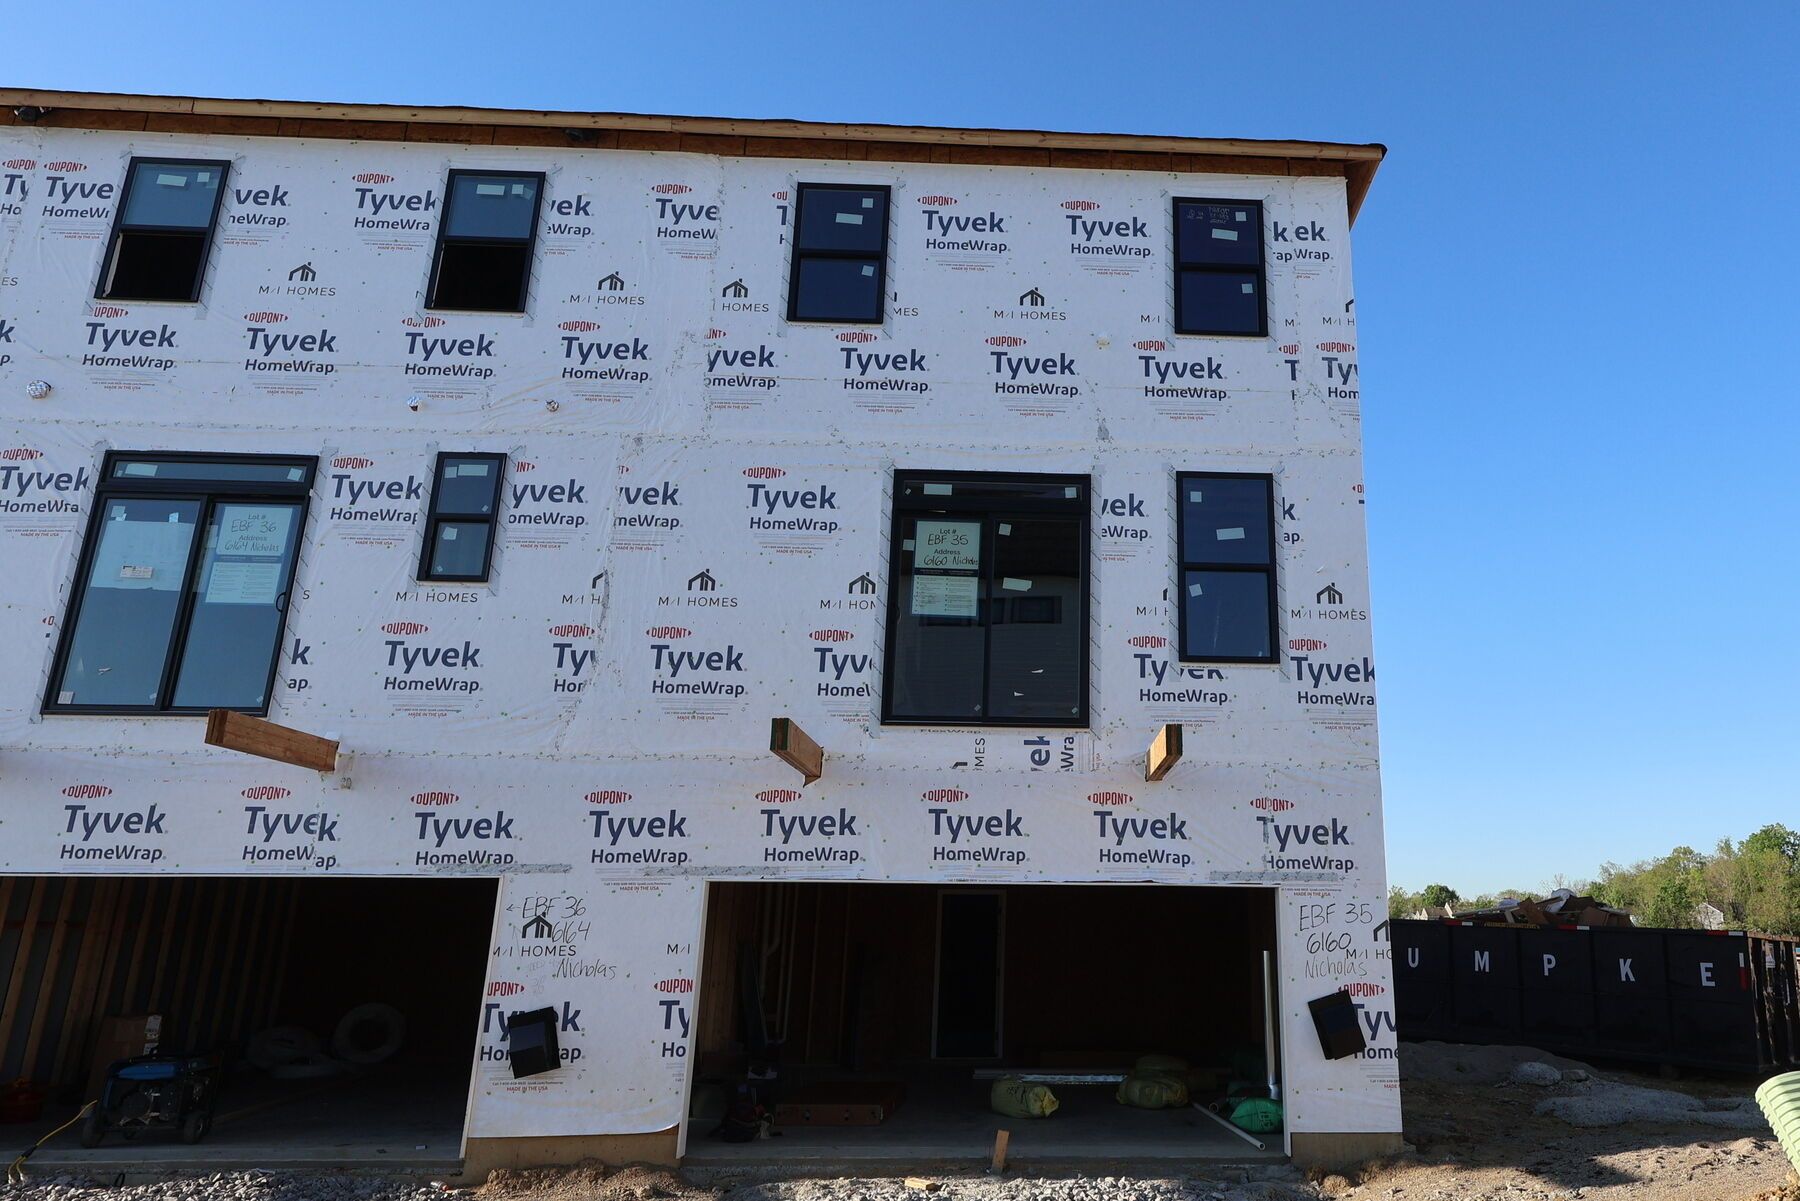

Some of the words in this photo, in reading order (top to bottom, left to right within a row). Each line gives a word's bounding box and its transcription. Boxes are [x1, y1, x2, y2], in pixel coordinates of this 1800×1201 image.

[7, 159, 36, 171] DUPON
[49, 162, 83, 173] DUPONT
[357, 173, 390, 184] DUPONT
[46, 176, 113, 204] Tyve
[235, 185, 288, 206] vek
[656, 184, 688, 194] DUPONT
[355, 188, 435, 215] Tyvek
[922, 196, 954, 206] DUPONT
[1065, 201, 1096, 211] DUPONT
[42, 206, 109, 219] HomeWr
[656, 198, 718, 225] Tyve
[354, 217, 430, 231] HomeWra
[547, 223, 591, 238] eWrap
[922, 210, 1005, 236] Tyvek
[1066, 214, 1148, 241] Tyvek
[657, 227, 716, 239] HomeW
[926, 238, 1007, 254] HomeWrap
[1071, 243, 1151, 258] HomeWrap
[1294, 248, 1330, 261] Wrap
[287, 287, 336, 296] HOMES
[598, 296, 645, 305] HOMES
[722, 302, 769, 312] HOMES
[94, 306, 124, 318] UPONT
[249, 312, 284, 323] DUPONT
[893, 307, 919, 316] MES
[1021, 311, 1067, 321] HOMES
[562, 321, 597, 332] DUPONT
[86, 322, 177, 352] Tyvek
[247, 327, 336, 356] Tyvek
[840, 332, 873, 343] DUPONT
[990, 336, 1023, 347] DUPONT
[405, 332, 495, 361] Tyvek
[561, 336, 648, 365] Tyvek
[1137, 340, 1165, 351] DUPON
[1320, 342, 1351, 353] DUPONT
[82, 354, 174, 371] HomeWrap
[707, 345, 775, 372] yvek
[840, 347, 926, 376] Tyvek
[990, 351, 1076, 380] Tyvek
[245, 359, 334, 375] HomeWrap
[405, 363, 493, 380] HomeWrap
[562, 367, 649, 383] HomeWrap
[1138, 355, 1223, 384] Tyvek
[704, 375, 776, 390] omeWrap
[843, 378, 928, 394] HomeWrap
[995, 382, 1079, 398] HomeWrap
[1144, 386, 1227, 401] HomeWrap
[3, 449, 39, 460] DUPONT
[334, 457, 369, 469] DUPONT
[748, 467, 781, 479] DUPONT
[331, 474, 423, 505] Tyvek
[512, 479, 585, 508] yvek
[619, 481, 679, 506] vek
[0, 500, 79, 513] HomeWra
[747, 484, 836, 514] Tyvek
[231, 519, 253, 532] EBF
[260, 521, 276, 533] 36
[508, 512, 584, 528] omeWrap
[750, 517, 837, 533] HomeWrap
[928, 534, 948, 545] EBF
[951, 534, 969, 545] 35
[1101, 525, 1148, 541] eWrap
[923, 555, 947, 566] 6160
[426, 593, 478, 603] HOMES
[688, 597, 738, 607] HOMES
[1319, 610, 1366, 620] HOMES
[387, 622, 424, 635] DUPONT
[554, 625, 590, 637] DUPONT
[652, 627, 687, 639] DUPONT
[814, 630, 849, 642] DUPONT
[1133, 636, 1167, 649] DUPONT
[1289, 639, 1322, 650] DUPONT
[385, 640, 480, 674] Tyvek
[650, 645, 743, 677] Tyvek
[814, 648, 872, 680] Tyv
[1290, 656, 1375, 688] Tyvek
[384, 676, 479, 694] HomeWrap
[652, 680, 744, 697] HomeWrap
[817, 683, 870, 697] Home
[1139, 689, 1228, 705] HomeWrap
[1297, 691, 1374, 705] HomeWra
[974, 738, 986, 767] MES
[68, 785, 108, 798] DUPONT
[247, 786, 286, 800] DUPONT
[416, 792, 455, 805] DUPONT
[590, 791, 627, 804] DUPONT
[761, 790, 796, 802] DUPONT
[928, 789, 964, 802] DUPONT
[1093, 792, 1128, 805] DUPONT
[65, 804, 166, 841] Tyvek
[245, 806, 338, 842] Tyvek
[415, 811, 514, 847] Tyvek
[589, 810, 687, 846] Tyvek
[760, 808, 857, 844] Tyvek
[928, 809, 1023, 843] Tyvek
[1093, 811, 1187, 846] Tyvek
[1256, 816, 1350, 852] Tyvek
[60, 844, 162, 863] HomeWrap
[242, 845, 336, 870] HomeWap
[416, 850, 514, 865] HomeWrap
[591, 849, 688, 865] HomeWrap
[765, 847, 859, 864] HomeWrap
[934, 847, 1025, 864] HomeWrap
[1099, 849, 1191, 865] HomeWrap
[522, 897, 560, 919] EBF
[561, 897, 586, 918] 36
[1300, 903, 1336, 931] EBF
[1345, 903, 1372, 924] 35
[552, 921, 591, 943] 6164
[521, 945, 577, 957] HOMES
[1307, 932, 1351, 954] 6160
[557, 959, 616, 979] Nicholas
[1305, 956, 1366, 979] Nicholas
[487, 982, 519, 996] UPONT
[660, 979, 693, 993] DUPON
